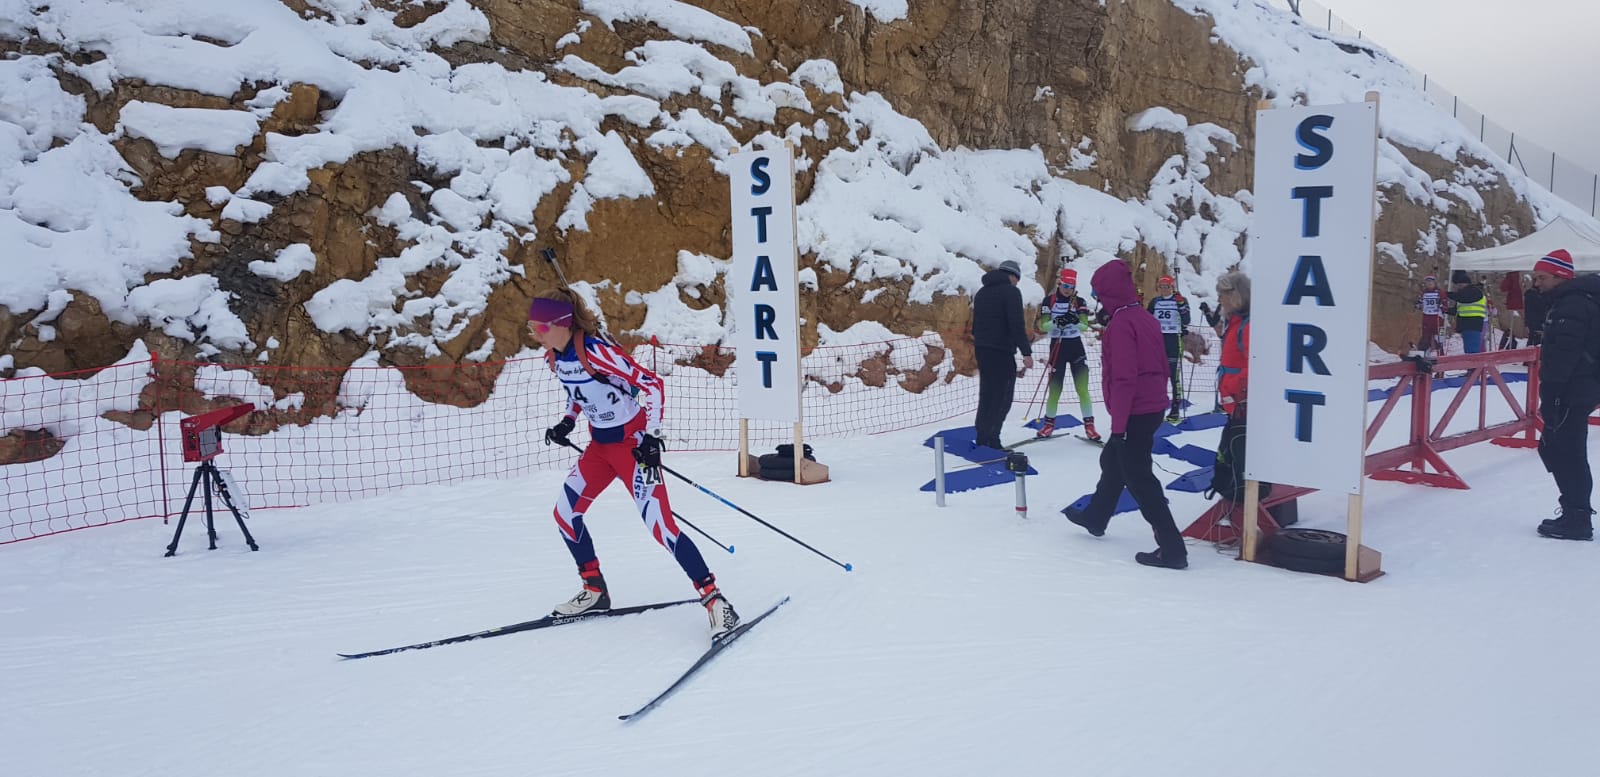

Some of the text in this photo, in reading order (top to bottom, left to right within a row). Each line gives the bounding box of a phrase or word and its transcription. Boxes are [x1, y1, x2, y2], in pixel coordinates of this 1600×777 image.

[751, 157, 779, 389] START
[1158, 310, 1171, 319] 26
[1281, 114, 1336, 443] START
